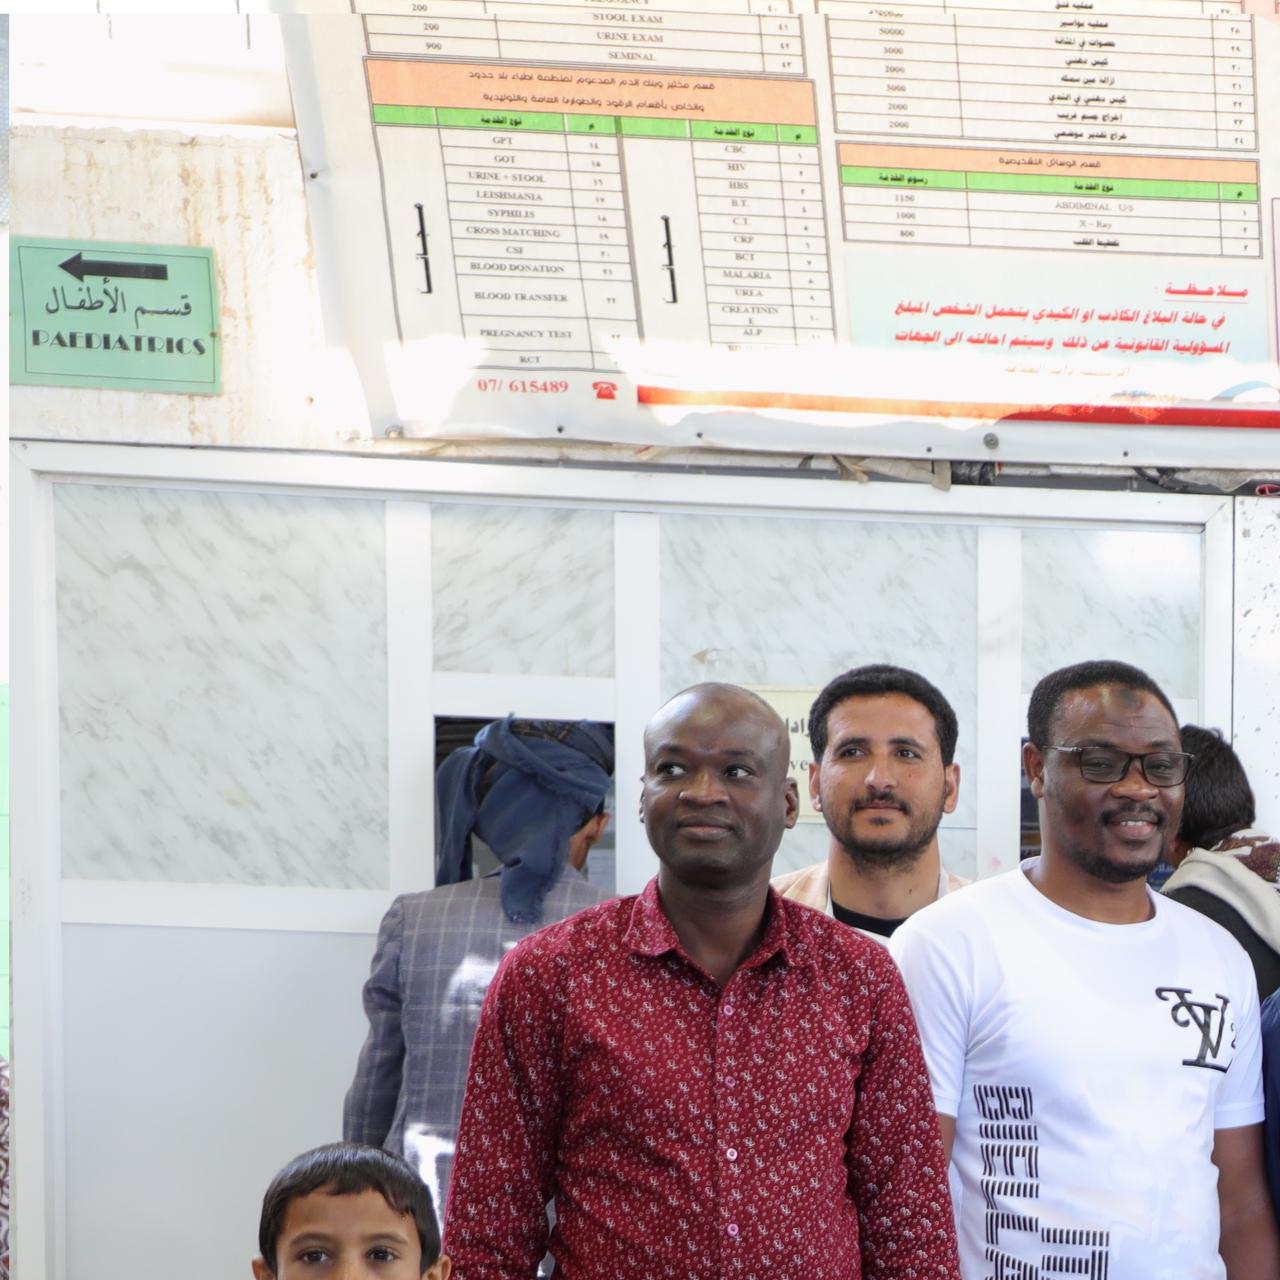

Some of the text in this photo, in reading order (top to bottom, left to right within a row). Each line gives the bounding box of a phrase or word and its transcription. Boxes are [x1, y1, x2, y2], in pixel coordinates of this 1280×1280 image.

[631, 14, 663, 24] EXAM
[597, 31, 664, 42] URINE EXAM
[608, 51, 656, 61] SEMINAL
[469, 71, 493, 80] حدود
[693, 81, 715, 90] قسم
[493, 136, 513, 145] GPT
[725, 145, 744, 153] CBC
[494, 155, 516, 163] GOT
[1080, 160, 1101, 168] قسم
[728, 163, 747, 171] HIV
[469, 171, 546, 183] URINE STOOL
[879, 173, 928, 184] رسوم الخدمة
[729, 181, 749, 189] HBS
[476, 190, 543, 201] LEISHMANIA
[488, 209, 535, 218] SYPHILIS
[1097, 220, 1112, 229] Ray
[467, 226, 560, 238] CROSS MATCHING
[506, 246, 524, 254] CSF
[470, 262, 565, 273] BLOOD DONATION
[723, 270, 772, 280] MALARIA
[475, 291, 568, 302] BLOOD TRANSFER
[735, 289, 763, 297] UREA
[46, 277, 192, 328] قسم الأطفال
[895, 299, 929, 316] المبلغ
[722, 306, 779, 314] CREATININ
[933, 301, 982, 318] الشخص
[985, 303, 1028, 320] يتحمل
[1033, 305, 1078, 324] الكيدي
[1098, 309, 1138, 324] الكاذب
[1144, 309, 1177, 326] البلاغ
[1182, 311, 1207, 326] حالة
[1212, 314, 1226, 331] في
[480, 329, 573, 338] PREGNANCY TEST
[895, 329, 941, 343] الجهات
[32, 329, 206, 355] PAEDIATRICS
[1010, 333, 1053, 350] وسيتم
[1062, 335, 1086, 349] ذلك
[1091, 337, 1109, 353] عن
[1115, 338, 1169, 354] القانونية
[1173, 341, 1231, 357] المسؤولية
[478, 379, 569, 393] 07/ 615489
